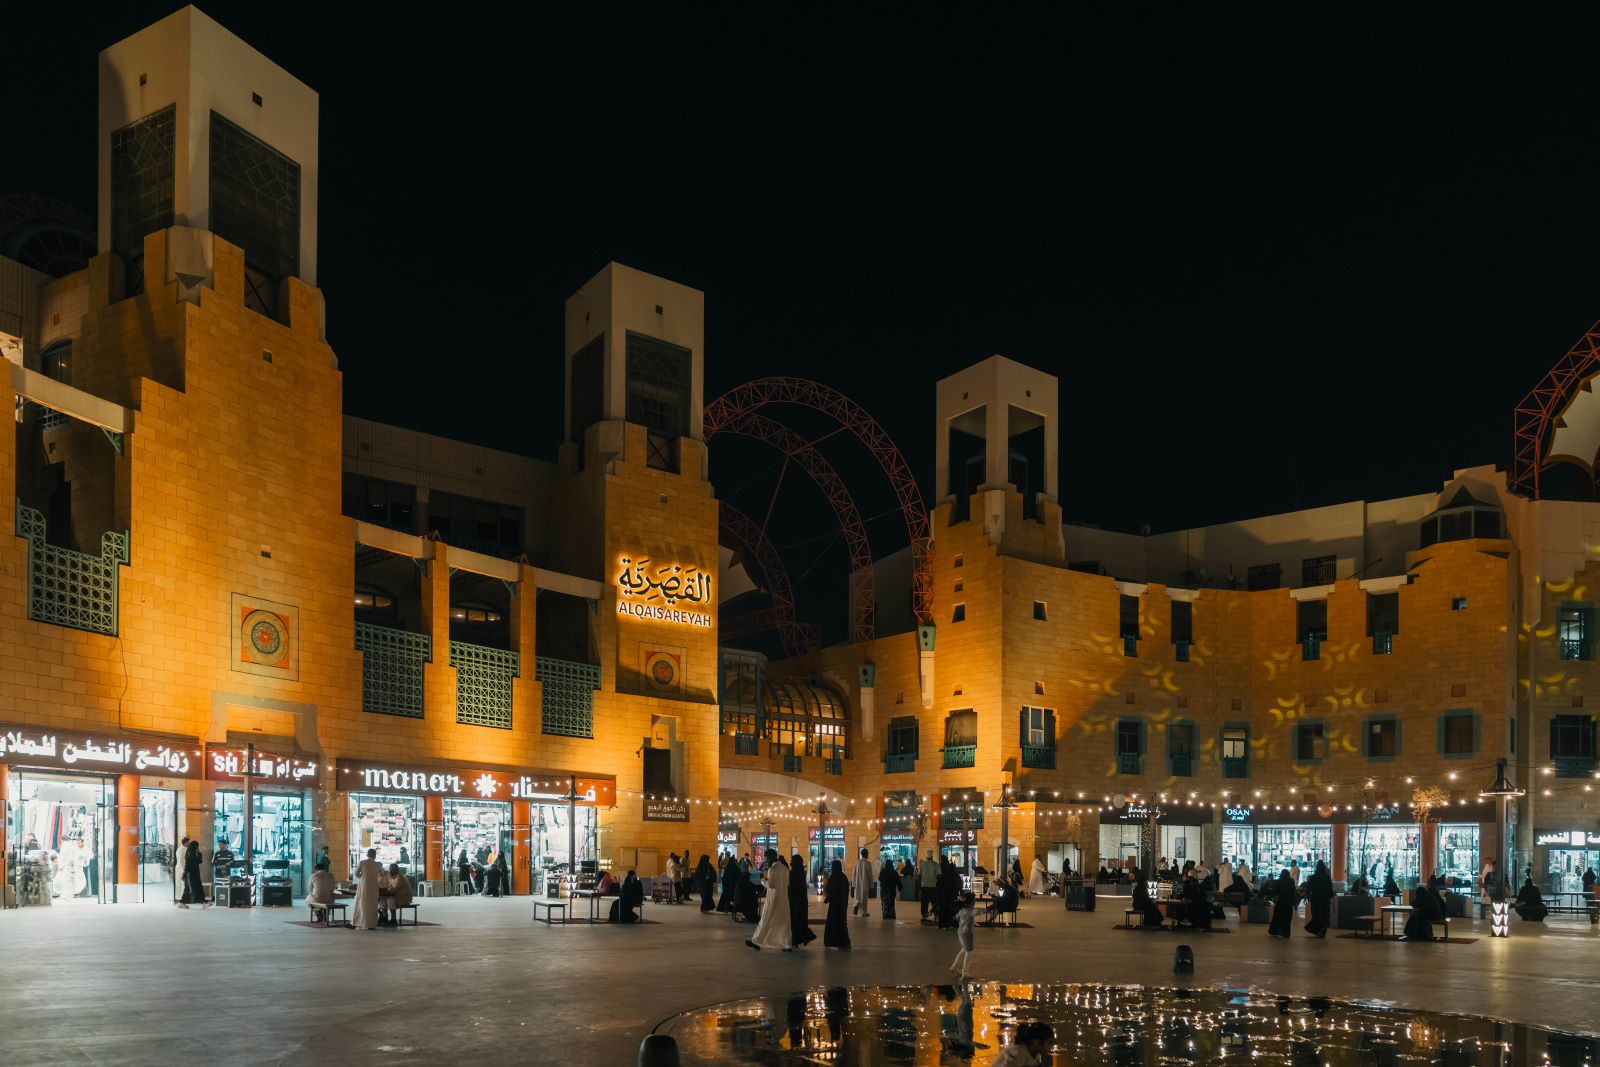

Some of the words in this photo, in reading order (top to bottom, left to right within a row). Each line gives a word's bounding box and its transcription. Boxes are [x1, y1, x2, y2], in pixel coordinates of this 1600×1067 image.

[618, 601, 712, 626] ALQAISAREYAH
[365, 768, 462, 793] manar
[1226, 808, 1250, 816] OSAN
